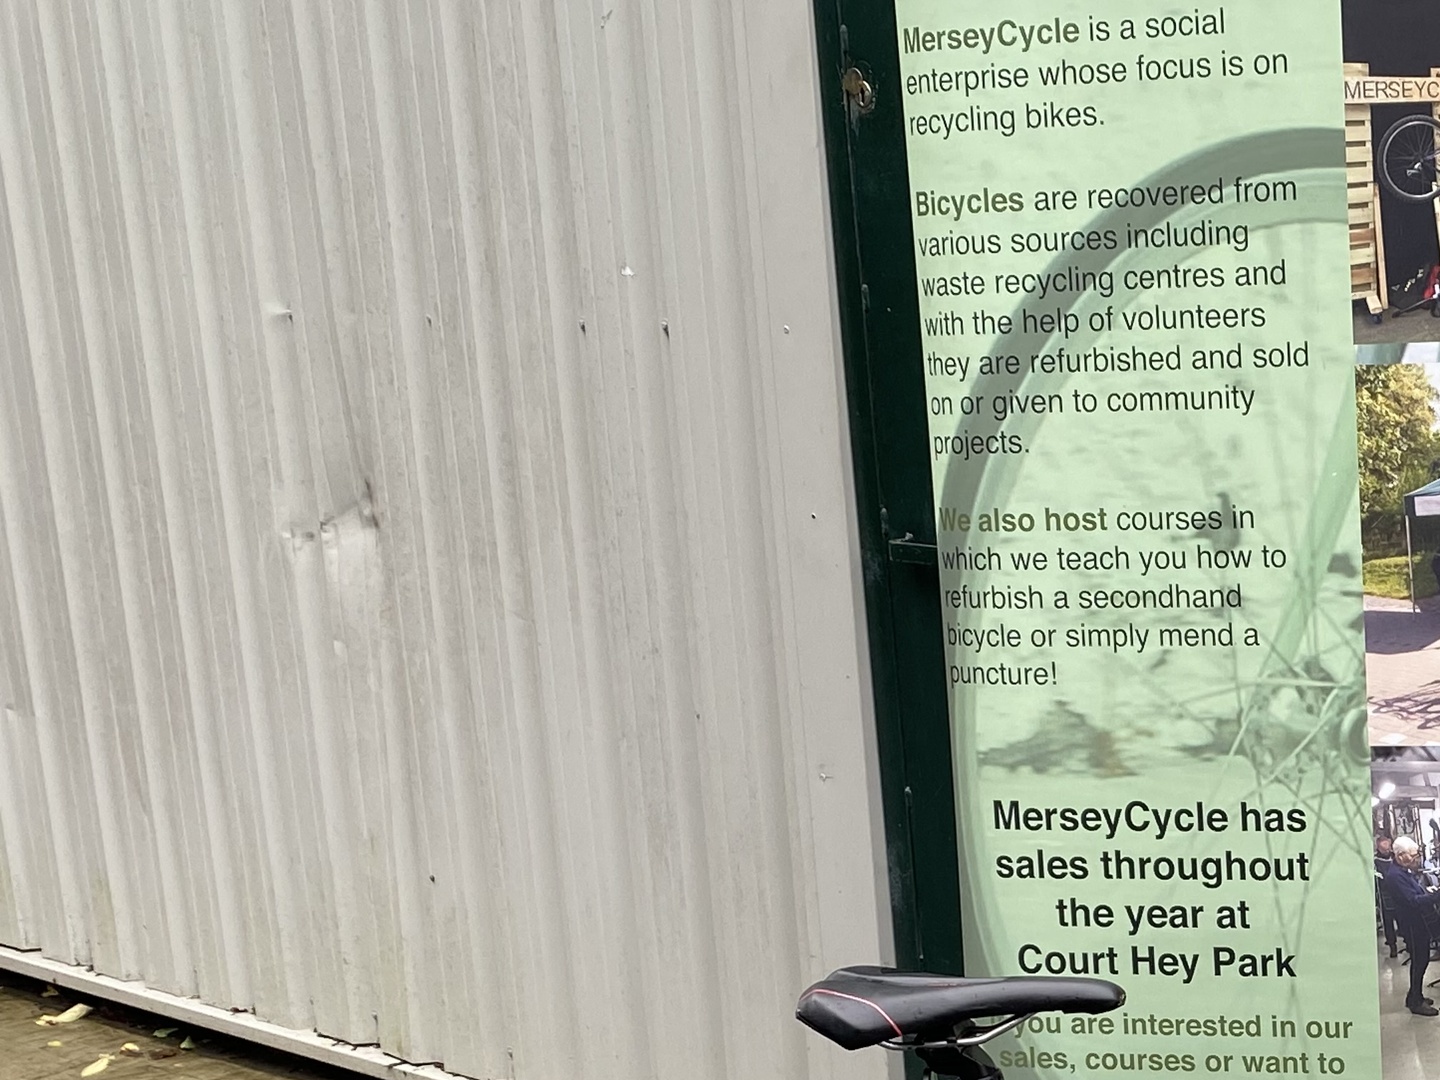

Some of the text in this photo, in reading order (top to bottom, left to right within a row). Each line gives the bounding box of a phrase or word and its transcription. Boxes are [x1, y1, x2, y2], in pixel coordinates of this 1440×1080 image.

[903, 8, 1226, 54] MerseyCycle is a social
[906, 52, 1289, 96] enterprise whose focus is on
[910, 102, 1105, 140] recycling bikes.
[916, 177, 1297, 222] Bicycles are recovered from
[918, 220, 1249, 257] various sources including
[921, 260, 1287, 299] waste recycling centres and
[924, 305, 1266, 339] with the help of volunteers
[927, 342, 1310, 382] they are refurbished and sold
[931, 385, 1255, 421] on or given to community
[934, 432, 1030, 460] projects.
[939, 505, 1255, 531] We also host courses in
[941, 544, 1287, 576] which we teach you how to
[945, 584, 1242, 610] refurbish a secondhand
[947, 623, 1260, 652] bicycle or simply mend a
[950, 661, 1058, 688] puncture!
[993, 800, 1308, 839] MerseyCycle has
[996, 850, 1309, 888] sales throughout
[1056, 898, 1250, 935] the year at
[1018, 944, 1297, 984] Court Hey Park
[1071, 1016, 1115, 1035] are
[1123, 1013, 1261, 1039] interested
[1271, 1012, 1296, 1039] in
[1305, 1017, 1353, 1040] our
[999, 1046, 1345, 1075] sales, courses or want to
